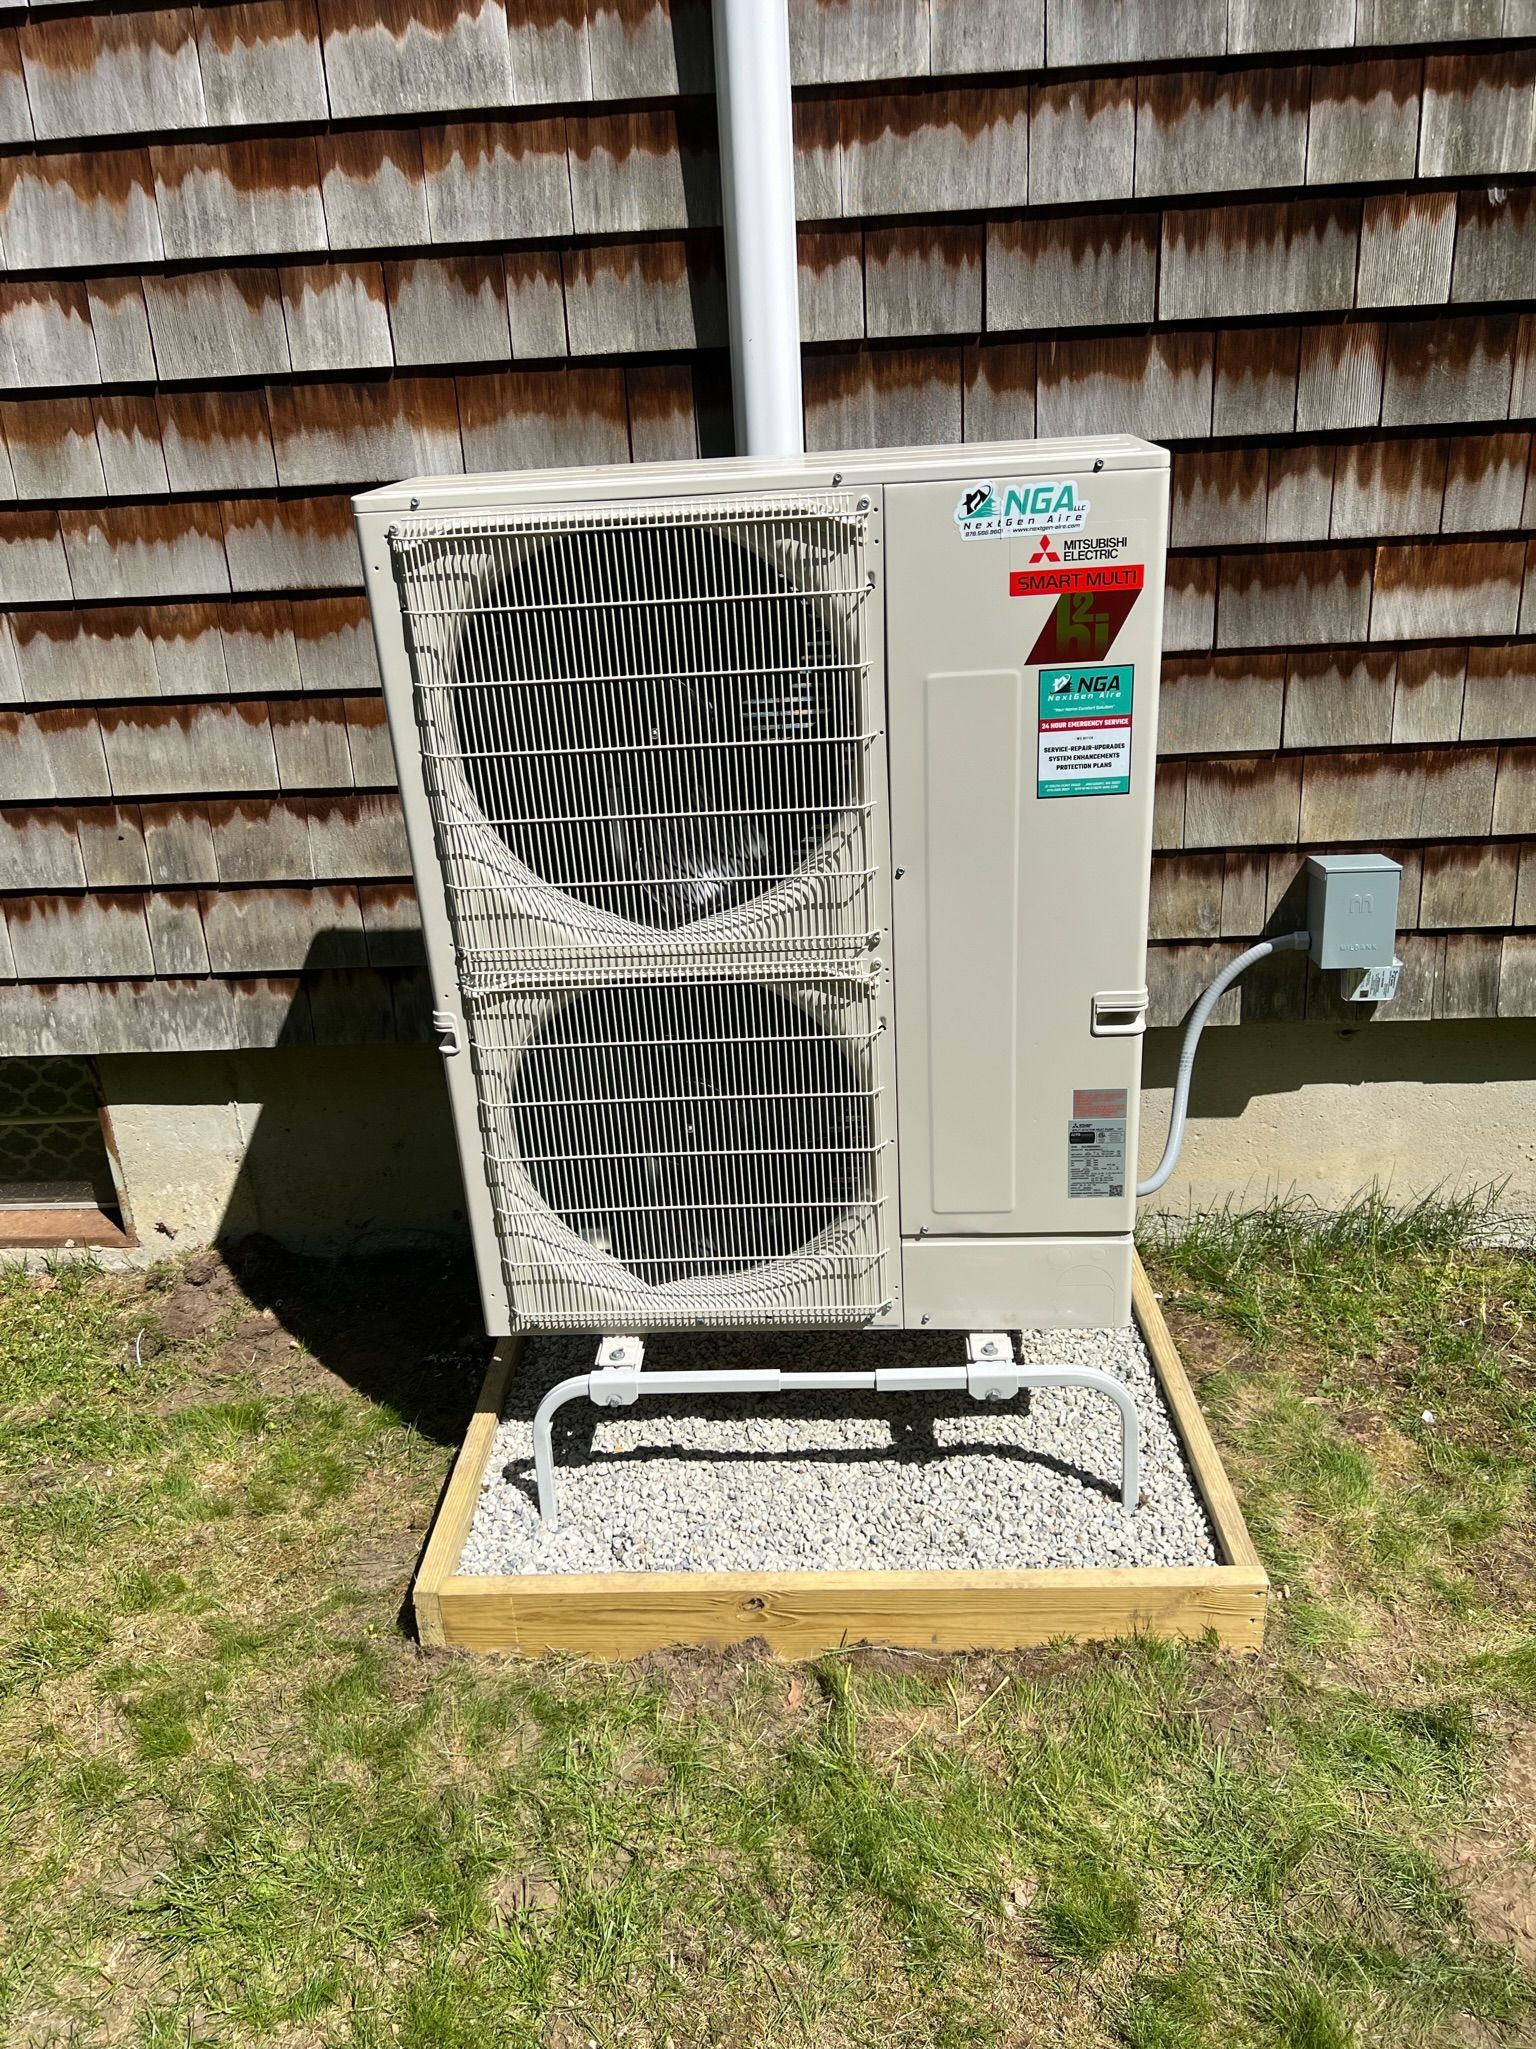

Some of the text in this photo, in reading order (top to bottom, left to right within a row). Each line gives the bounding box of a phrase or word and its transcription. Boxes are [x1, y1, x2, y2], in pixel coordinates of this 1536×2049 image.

[1004, 485, 1086, 516] NGA LLC
[963, 513, 1082, 530] NextGen Aire
[1063, 537, 1127, 551] MITSUBISHI
[1063, 548, 1119, 562] ELECTRIC
[1017, 570, 1137, 591] SMART MULTI
[1077, 675, 1120, 693] NGA
[1047, 691, 1122, 702] NextGen Aire
[1050, 721, 1067, 729] HOUR
[1067, 719, 1104, 728] EMERGENCY
[1104, 718, 1129, 726] SERVICE
[1073, 752, 1120, 761] ENHANCEMENTS
[1056, 761, 1112, 771] PROTECTION PLANS
